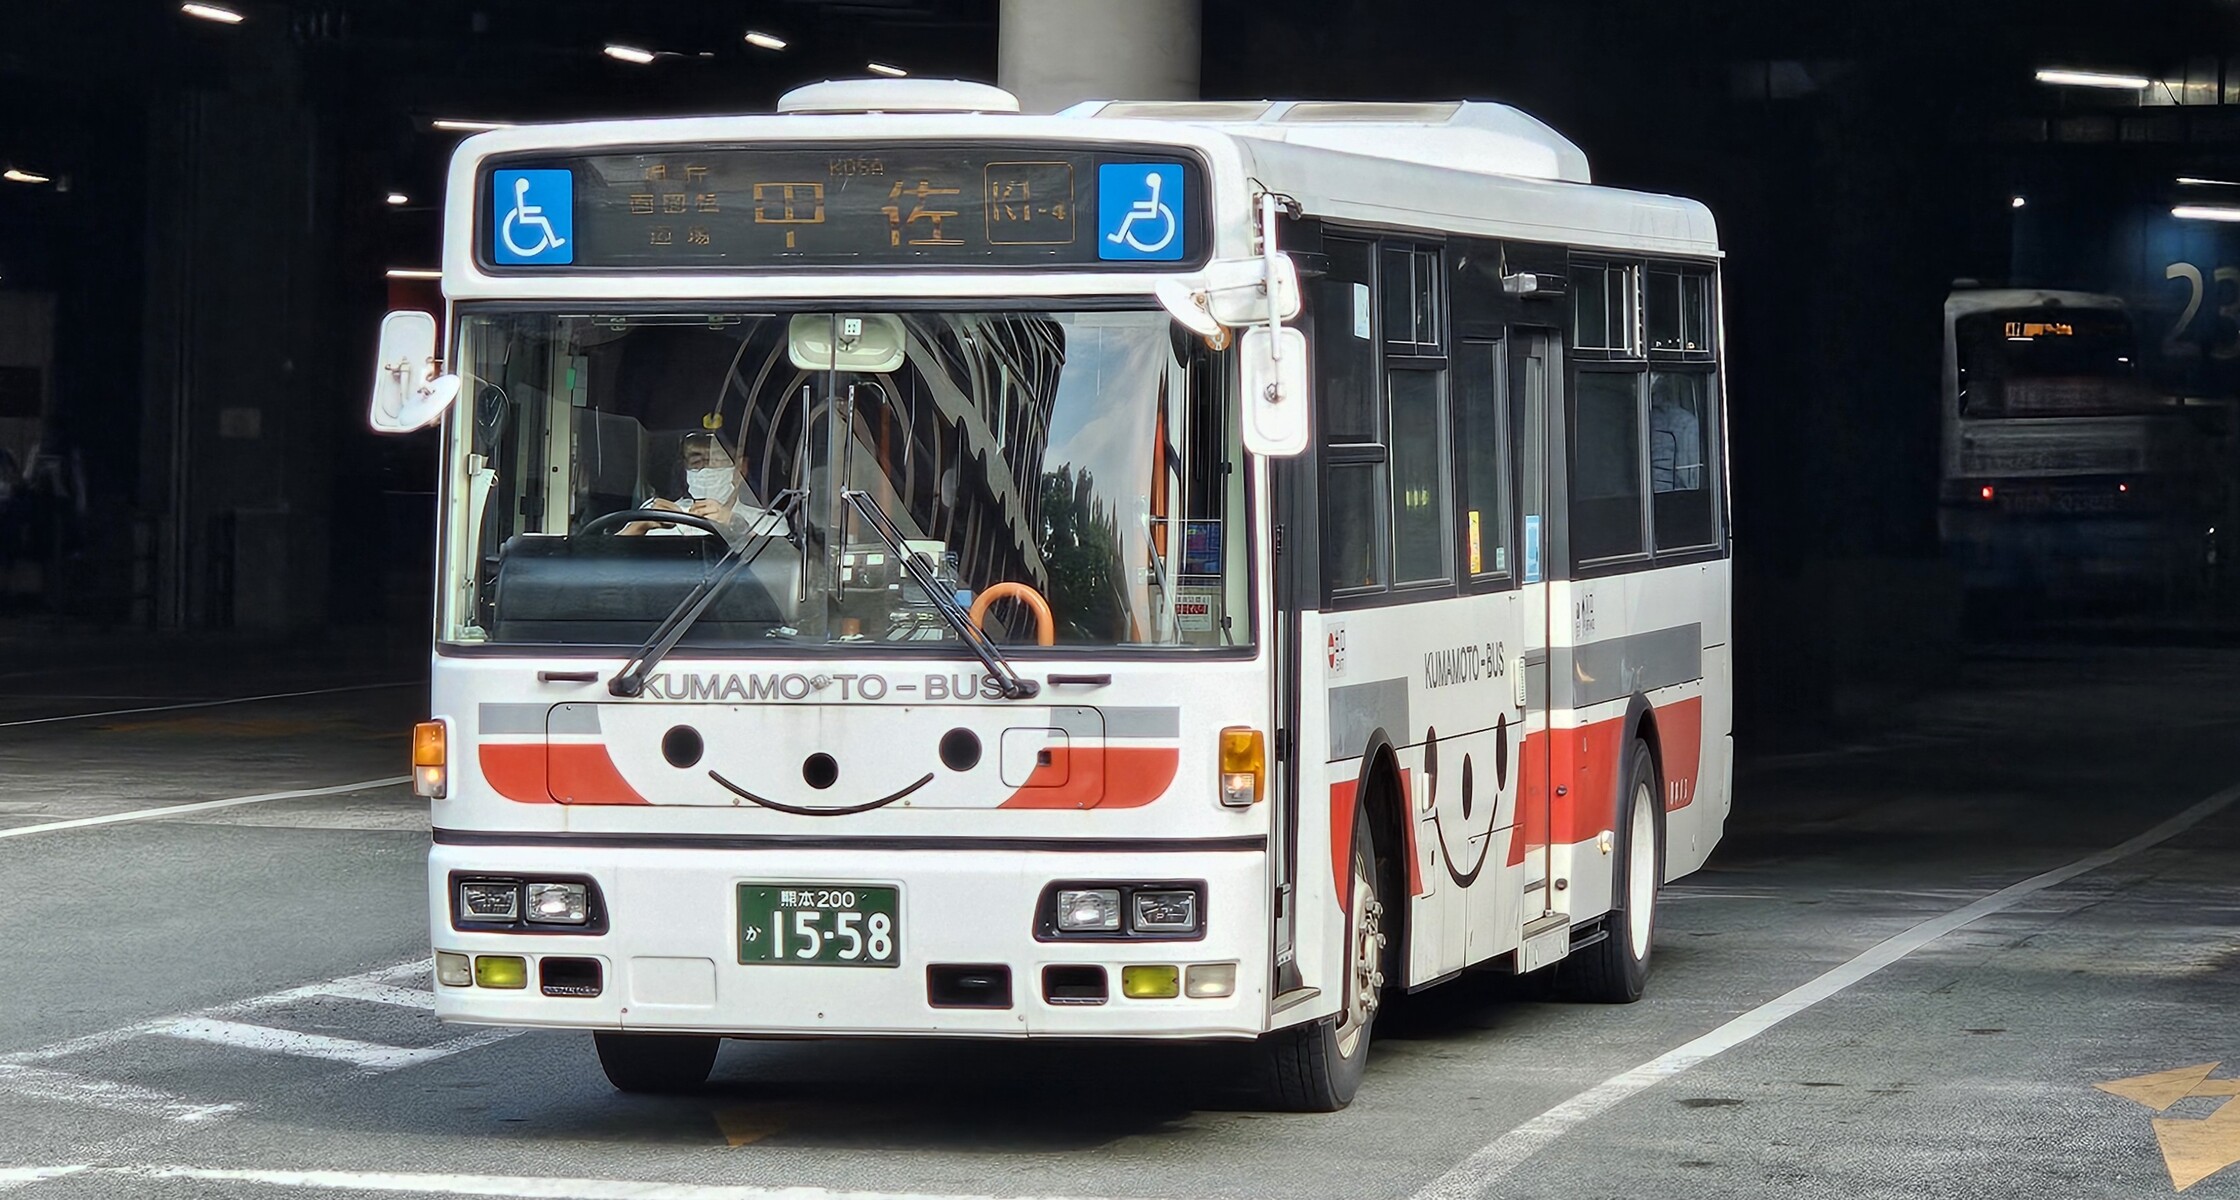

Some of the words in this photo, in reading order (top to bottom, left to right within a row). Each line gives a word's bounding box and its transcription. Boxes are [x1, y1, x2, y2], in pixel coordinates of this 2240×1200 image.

[829, 158, 884, 176] KOSA
[745, 925, 762, 942] か
[773, 910, 892, 960] 15-58
